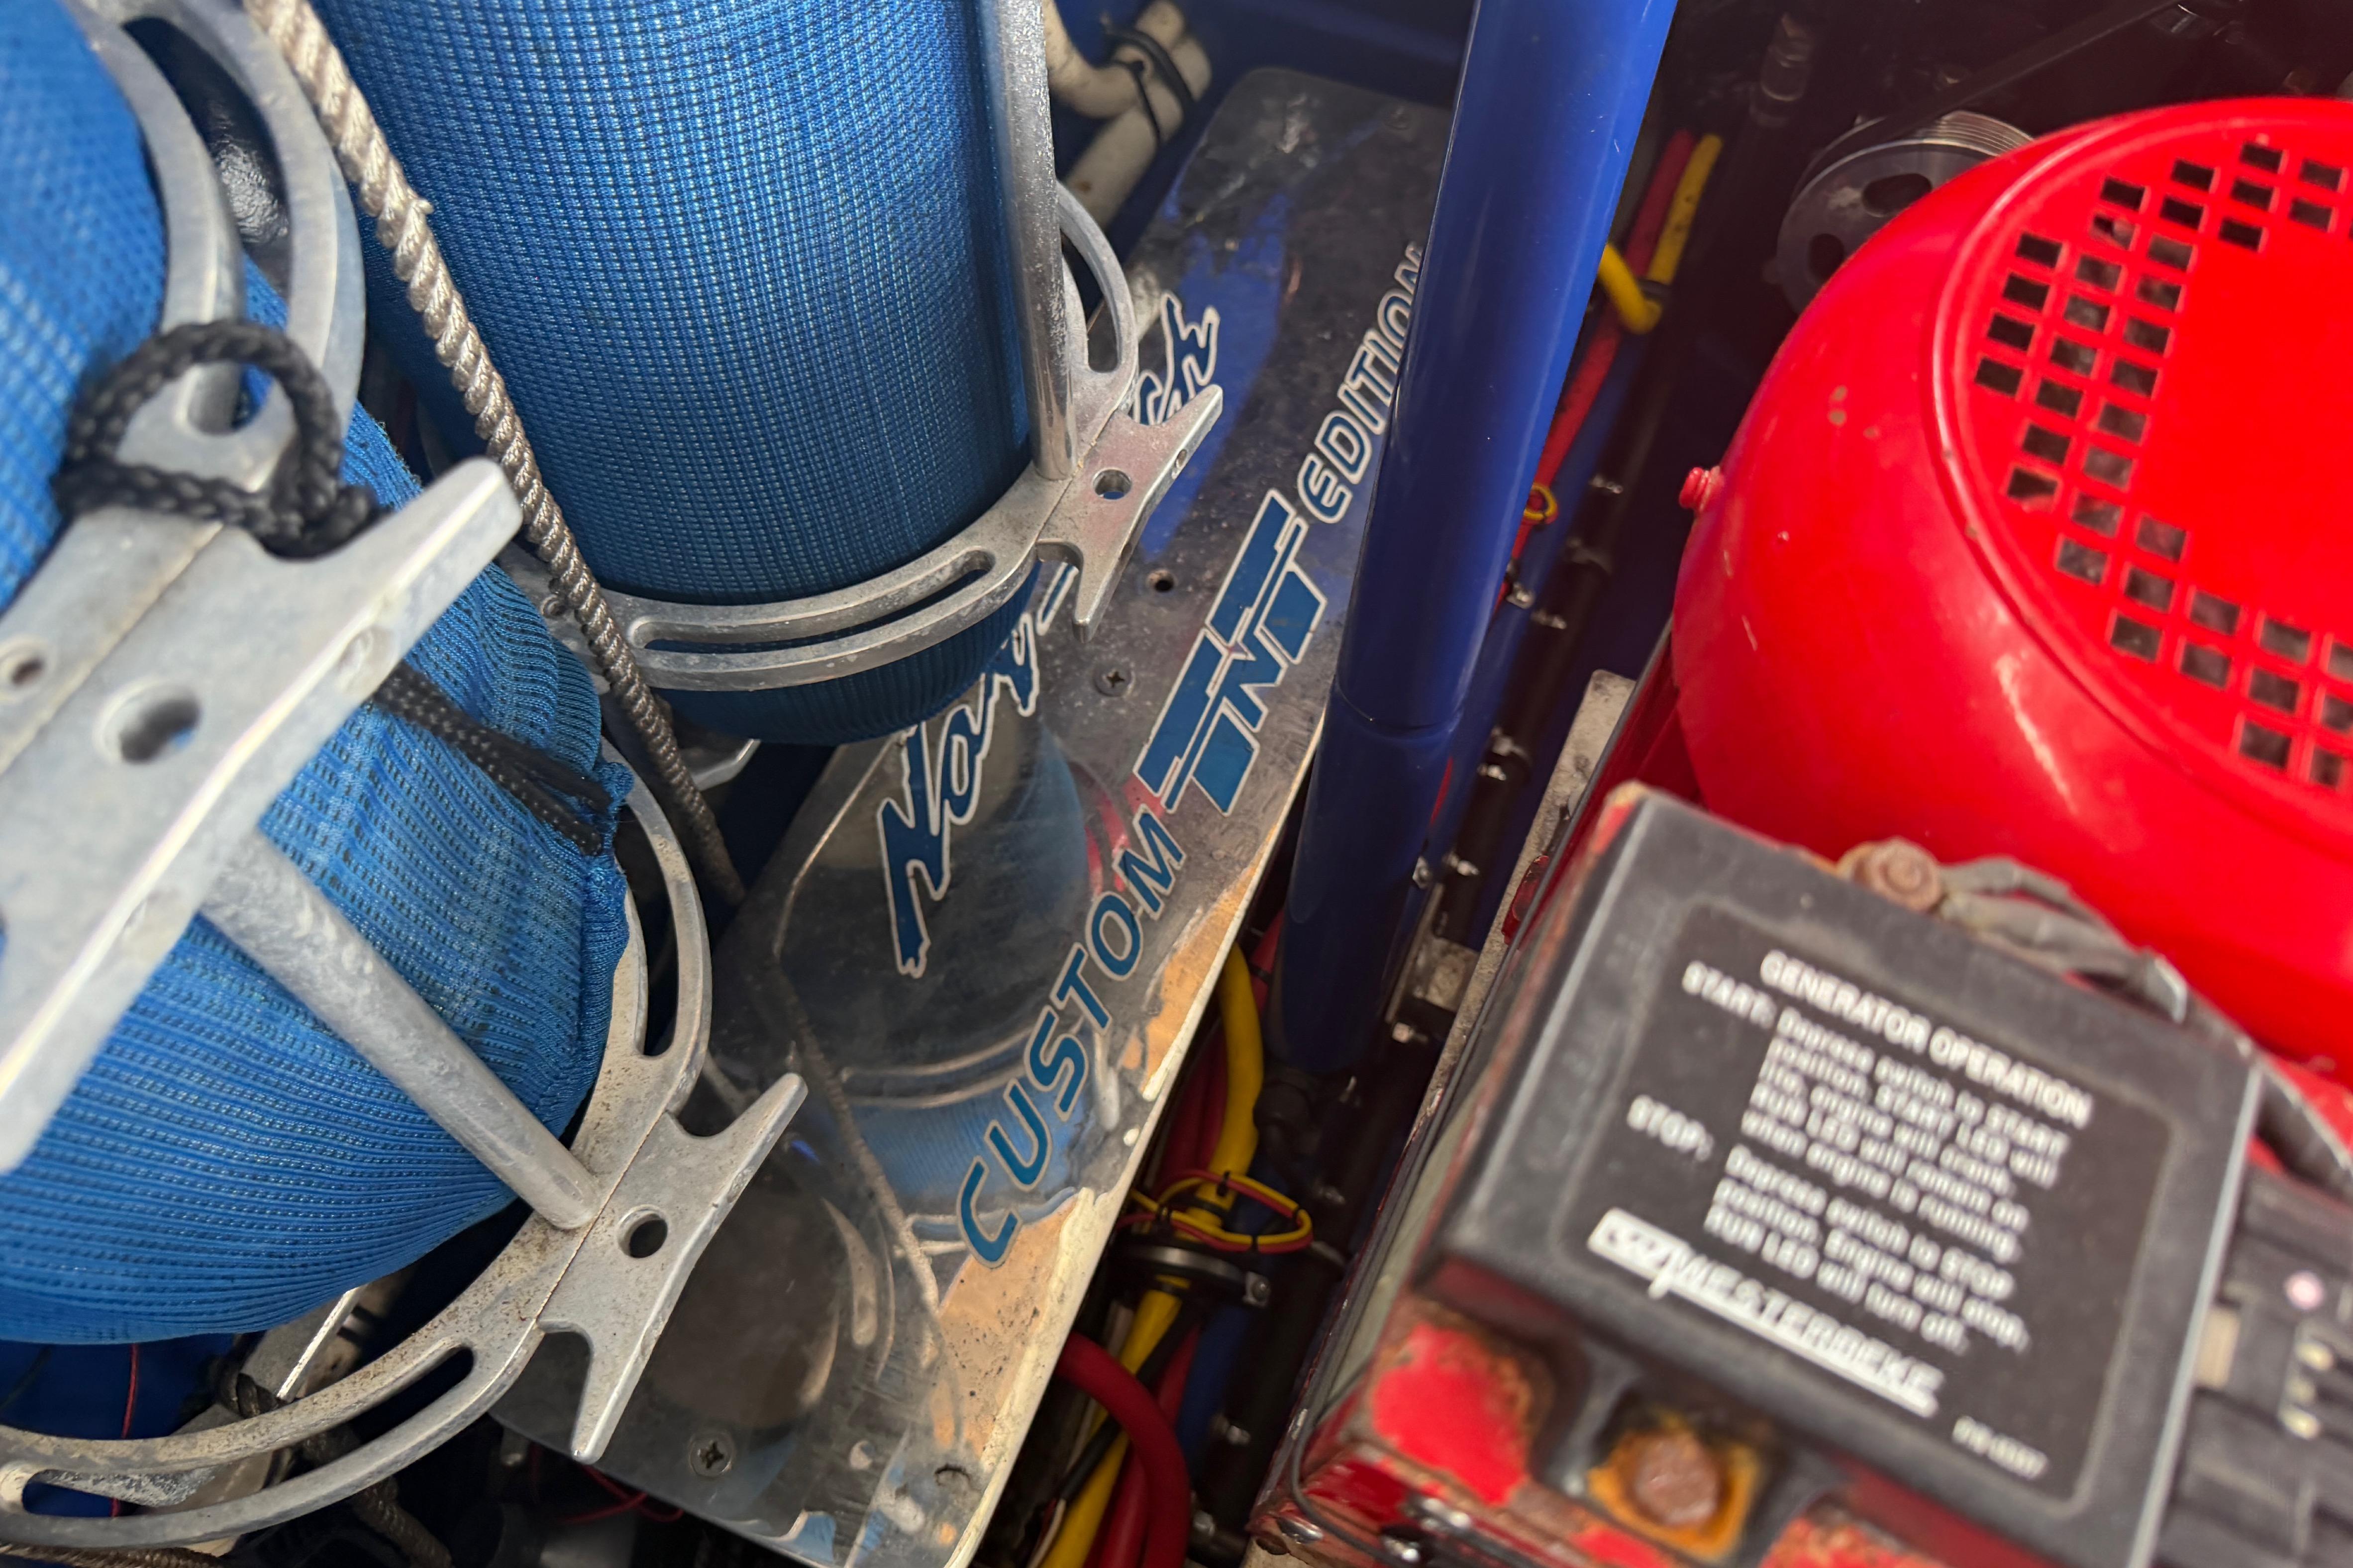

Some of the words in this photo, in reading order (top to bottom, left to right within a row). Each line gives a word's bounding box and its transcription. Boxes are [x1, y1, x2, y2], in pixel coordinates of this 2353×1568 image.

[956, 803, 1186, 1269] CUSTOM
[1132, 489, 1327, 816] TNT
[1760, 950, 1931, 1053] GENERATOR
[1929, 1027, 2092, 1128] OPERATION
